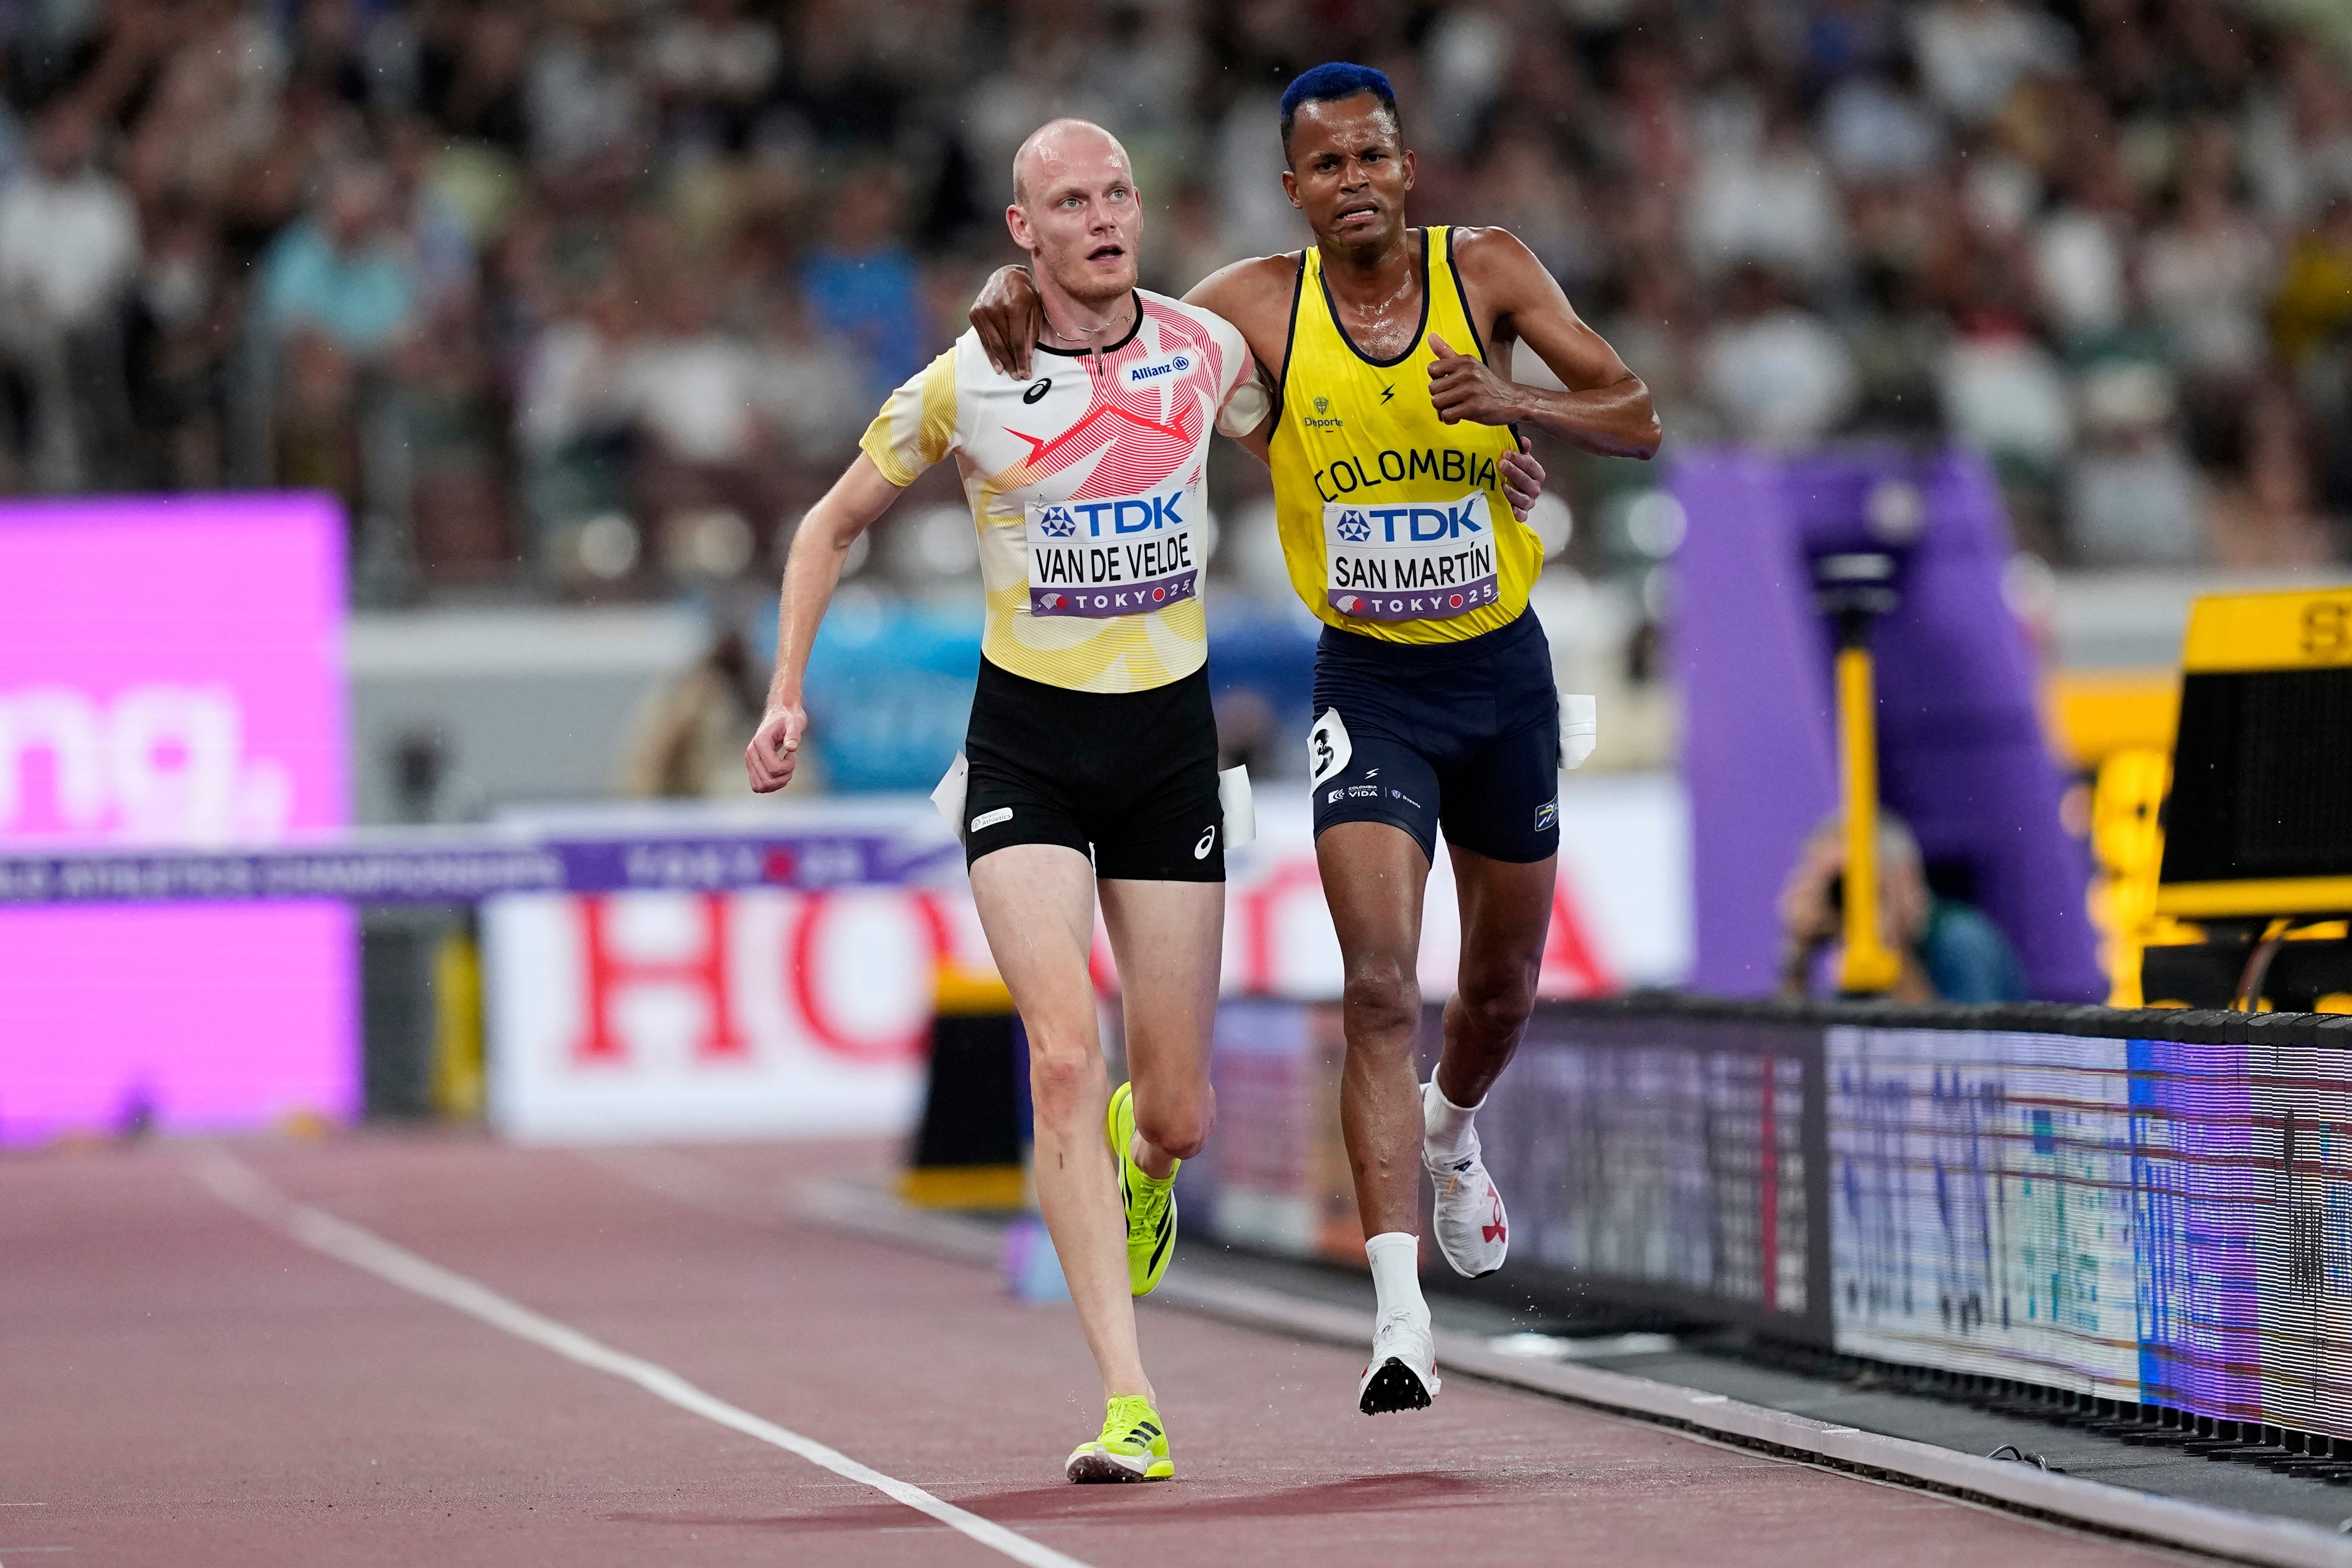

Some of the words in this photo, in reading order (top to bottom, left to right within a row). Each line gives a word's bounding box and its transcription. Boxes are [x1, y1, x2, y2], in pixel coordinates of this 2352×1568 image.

[1131, 364, 1172, 381] Allianz
[1304, 417, 1343, 428] Deporte
[1314, 449, 1496, 503] COLOMBIA
[1074, 490, 1183, 537] TDK
[1369, 498, 1482, 542] TDK
[1035, 549, 1084, 583] VAN
[1091, 547, 1121, 582] DE
[1126, 532, 1191, 578] VELDE
[1335, 556, 1387, 588] SAN
[1395, 541, 1490, 588] MARTÍN
[982, 814, 1011, 826] Athletics
